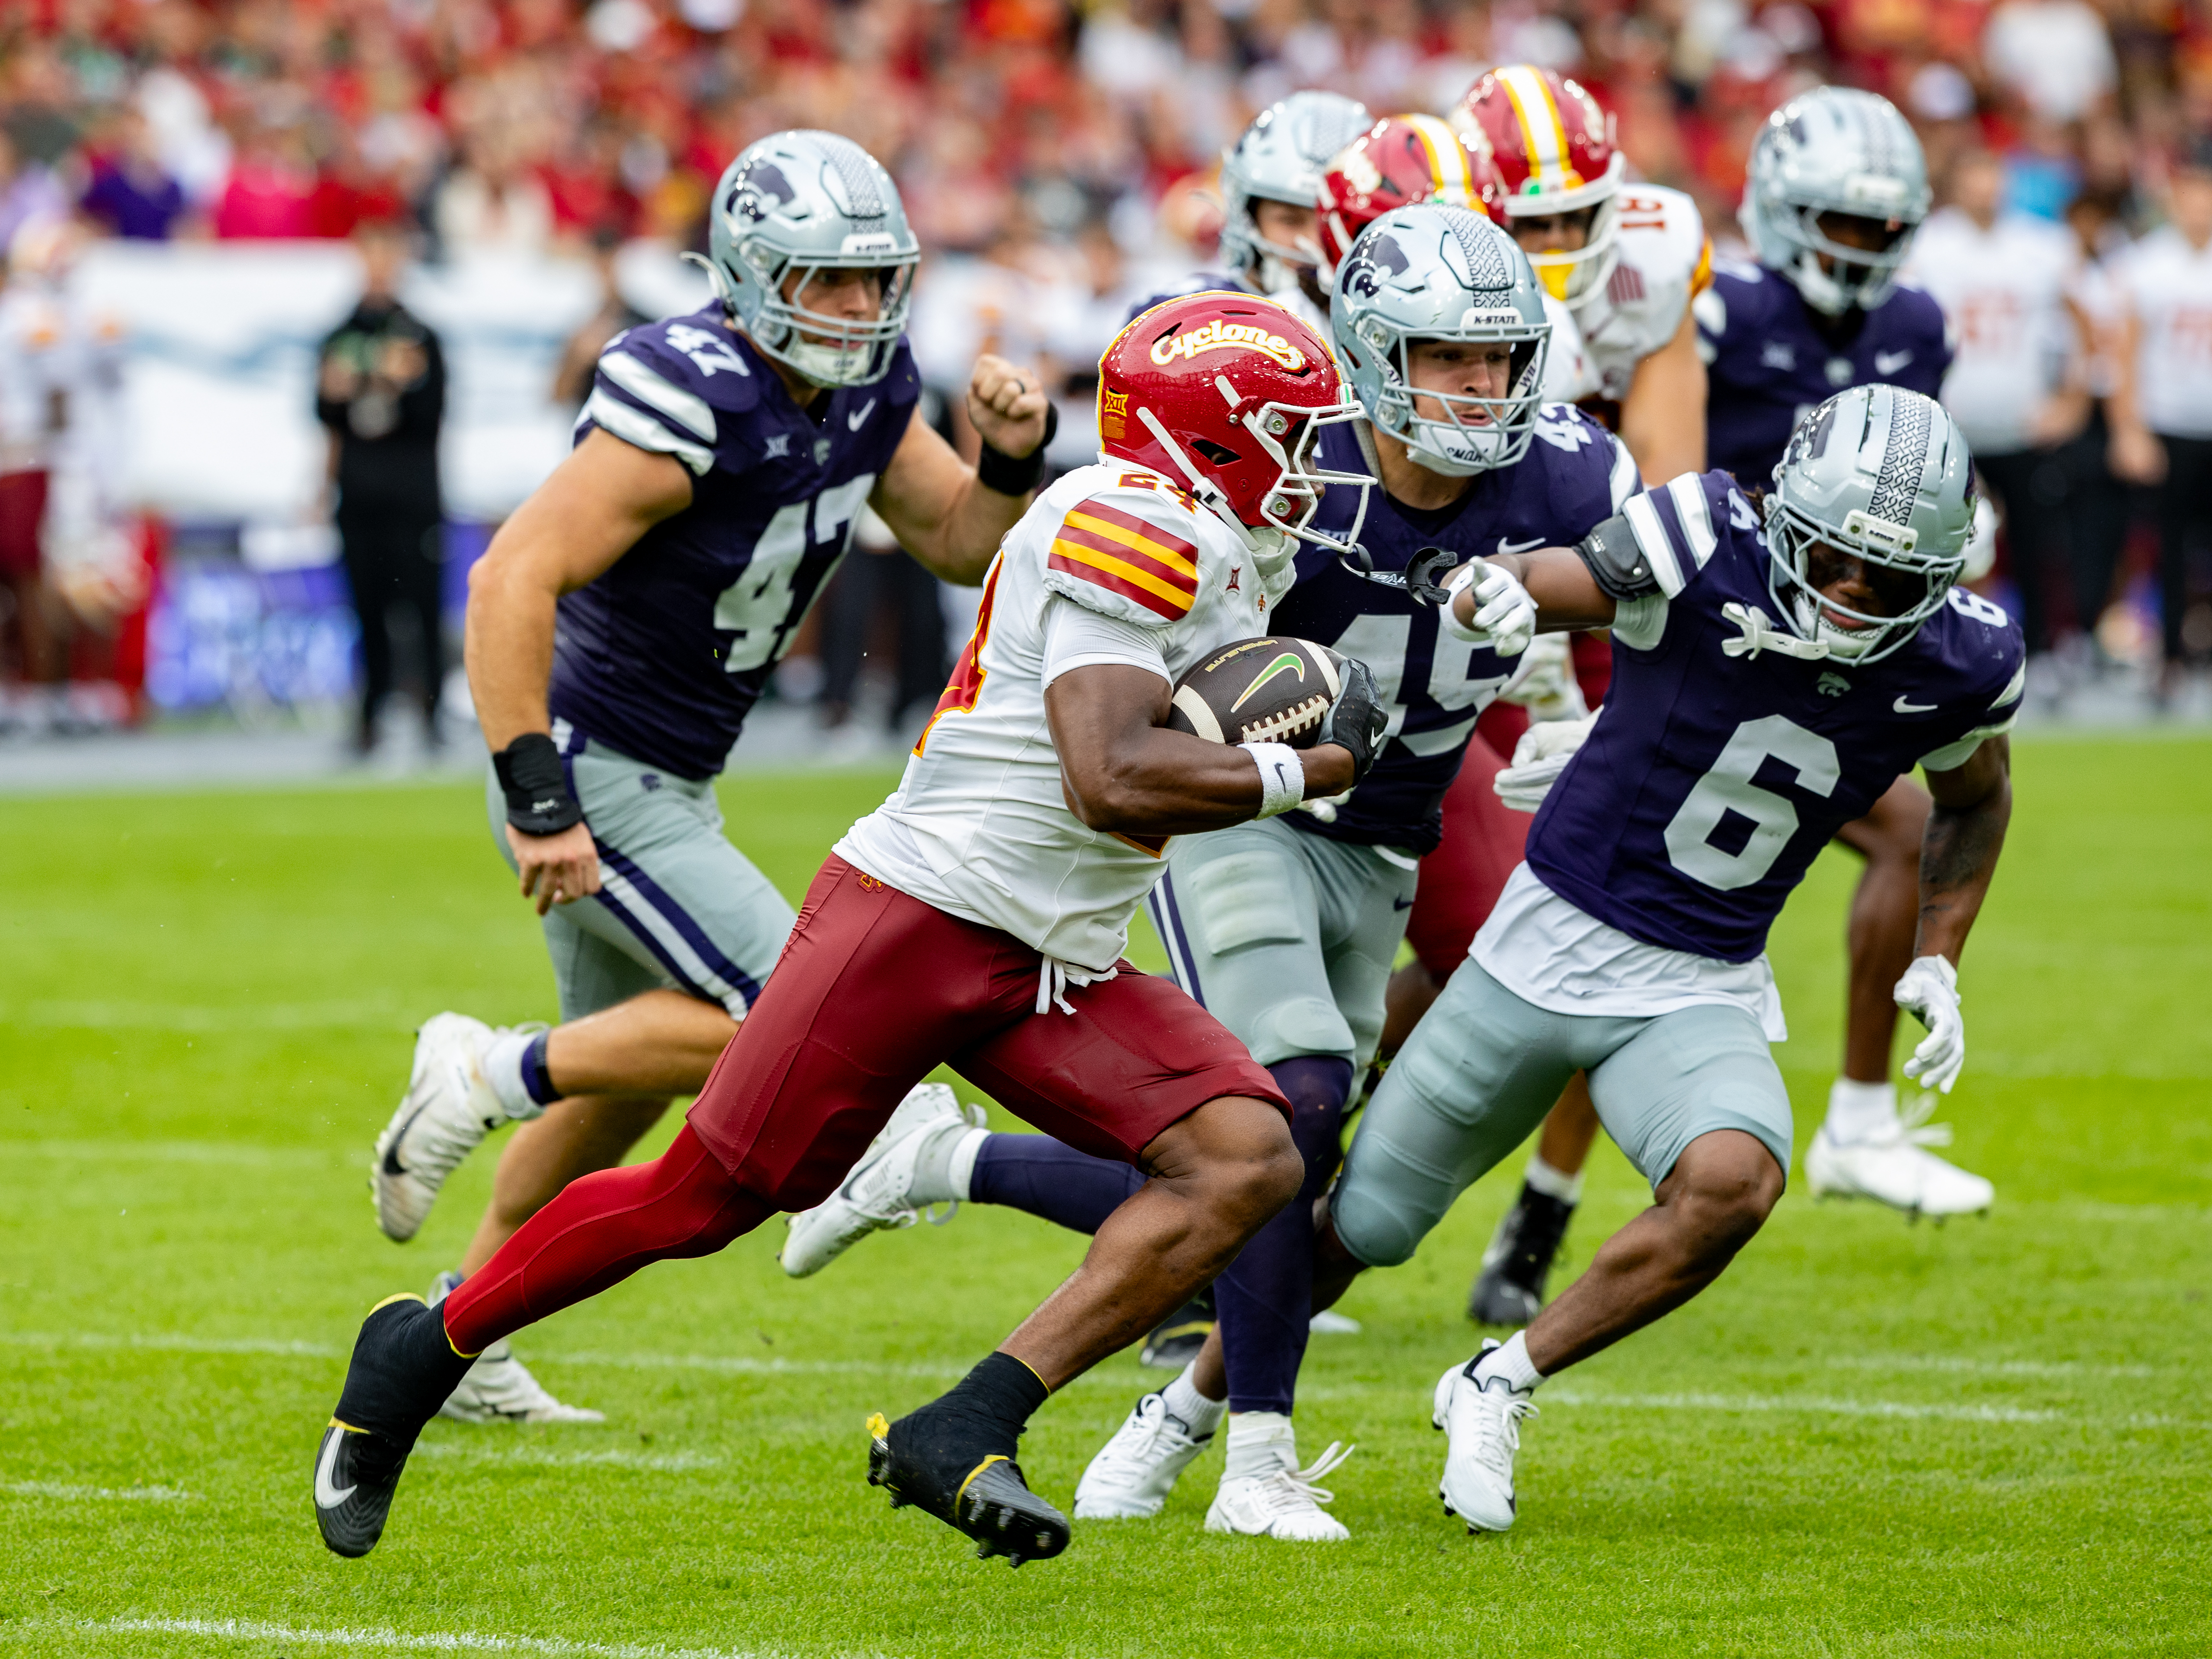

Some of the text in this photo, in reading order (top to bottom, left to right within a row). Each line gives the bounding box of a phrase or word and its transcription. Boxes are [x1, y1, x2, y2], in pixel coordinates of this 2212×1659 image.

[1149, 319, 1305, 371] Cyclones
[1474, 315, 1516, 324] K-STATE
[665, 323, 751, 377] 47
[714, 473, 875, 673] 47
[1947, 587, 2008, 628] 6
[1663, 714, 1841, 892] 6
